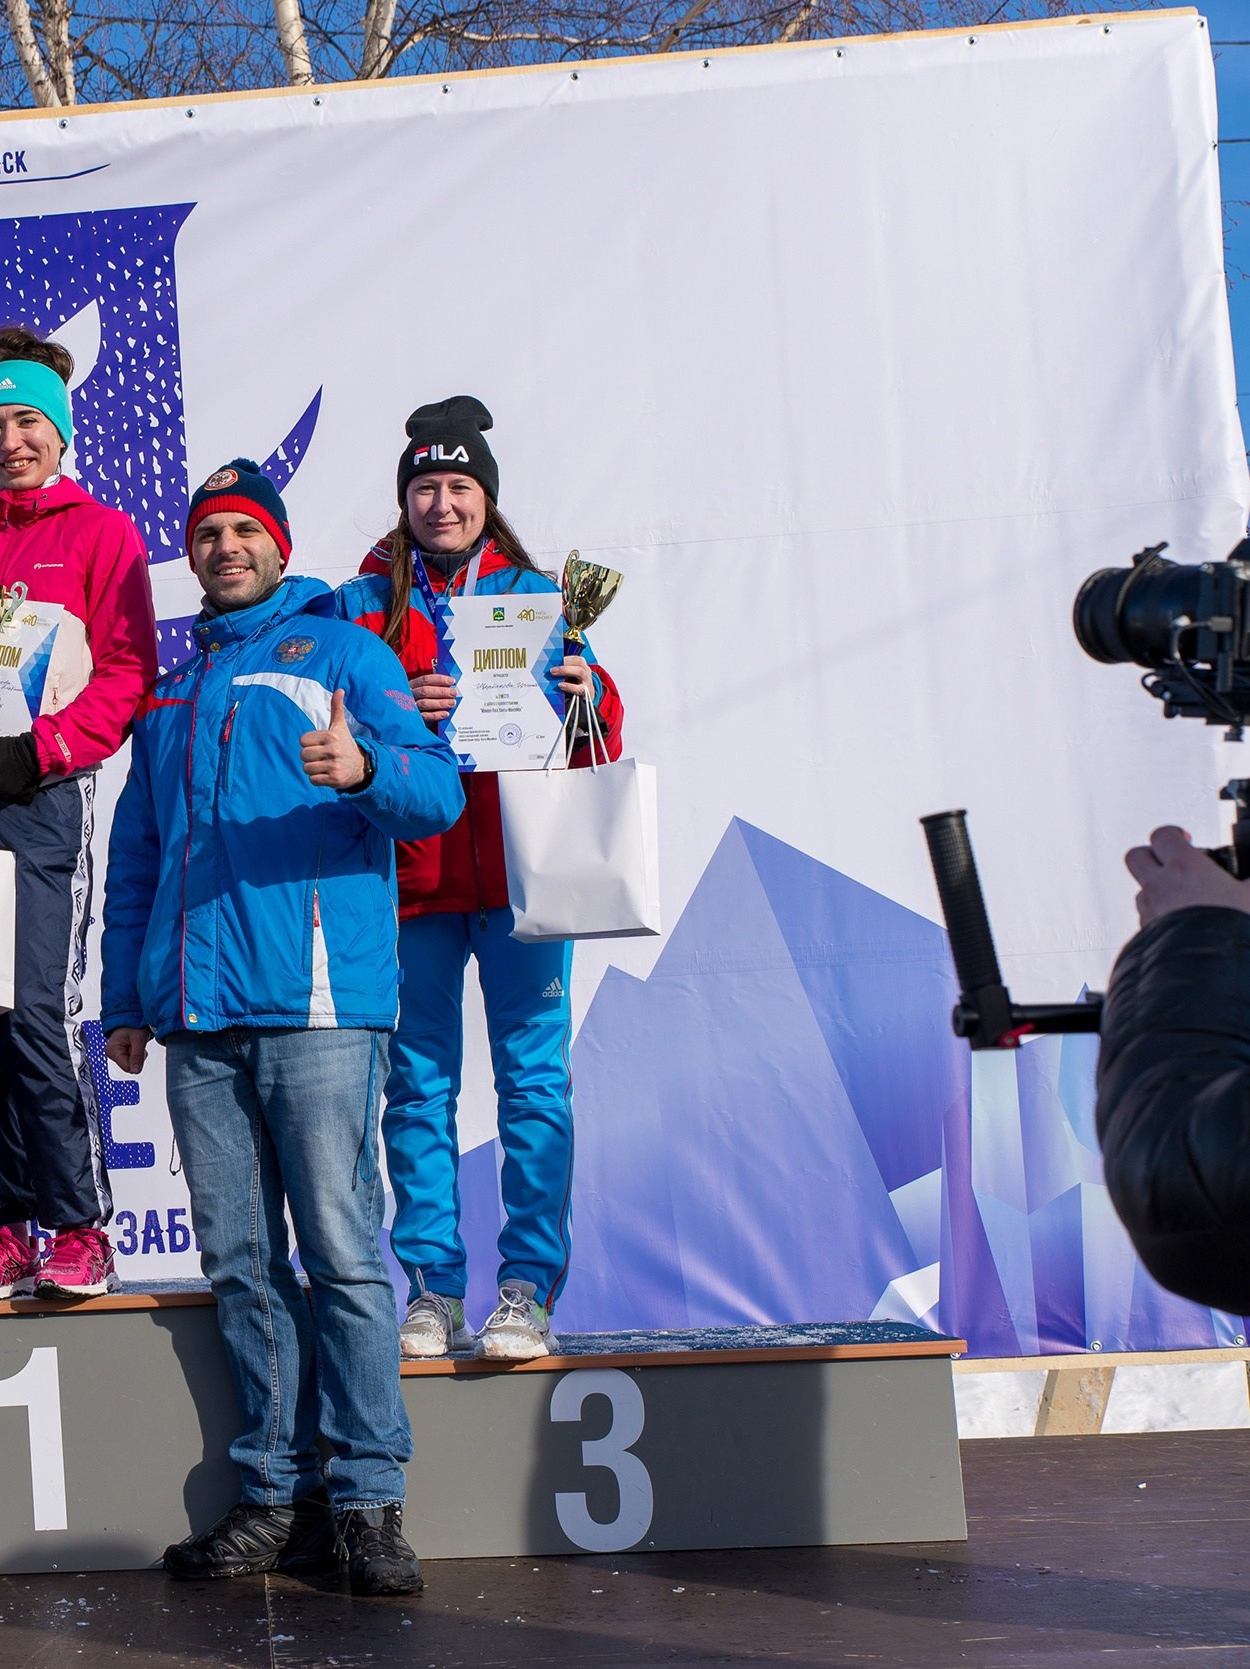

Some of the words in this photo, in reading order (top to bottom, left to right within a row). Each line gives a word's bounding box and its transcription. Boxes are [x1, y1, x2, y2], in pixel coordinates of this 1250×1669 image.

[413, 444, 470, 465] FILA
[473, 647, 527, 673] ДИПЛОМ
[542, 990, 565, 998] adidas
[550, 1366, 654, 1552] 3
